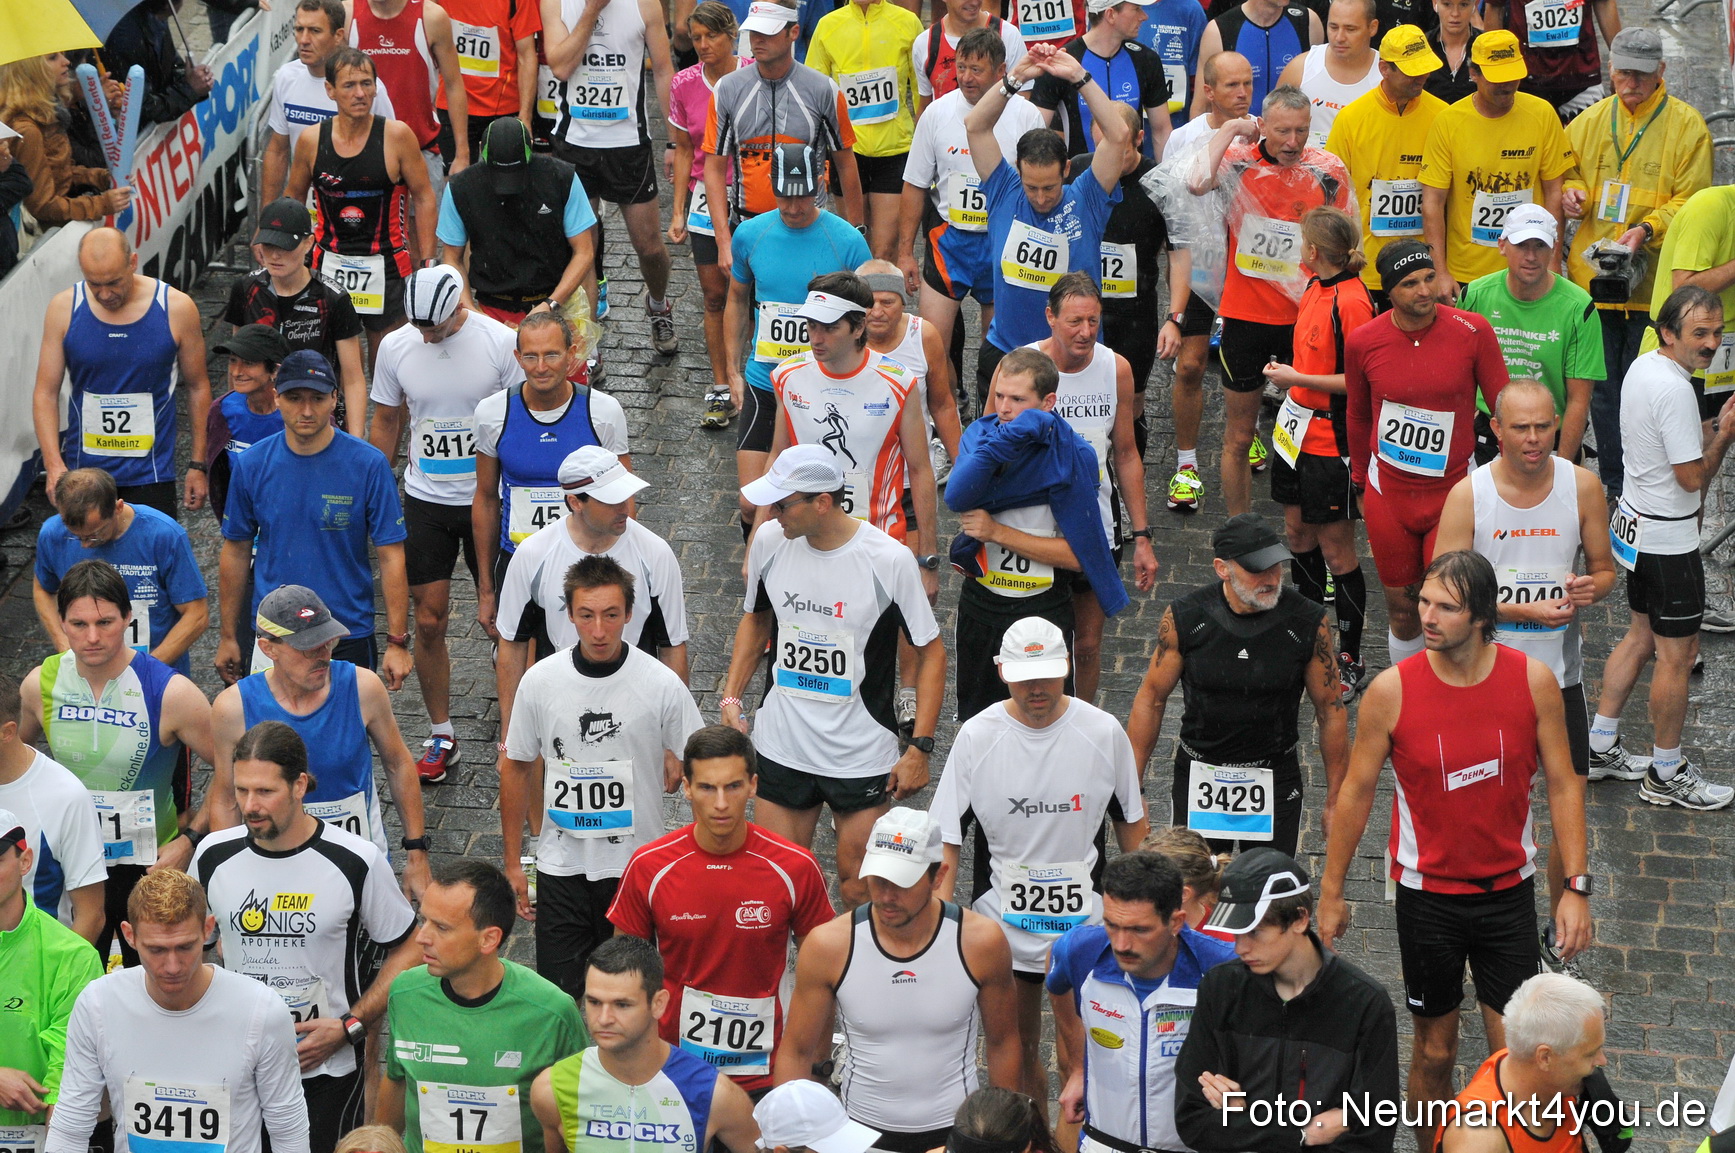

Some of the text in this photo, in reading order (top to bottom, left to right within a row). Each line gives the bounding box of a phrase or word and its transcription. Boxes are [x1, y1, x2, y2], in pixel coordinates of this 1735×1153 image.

[1021, 0, 1067, 22] 2101
[1533, 7, 1580, 30] 3023
[1032, 24, 1060, 33] Thomas
[1546, 31, 1568, 41] Ewald
[457, 37, 490, 59] 810
[576, 86, 624, 106] 3247
[846, 80, 895, 107] 3410
[582, 109, 617, 119] Christian
[959, 188, 987, 211] 15
[1388, 219, 1416, 228] Eduard
[1016, 241, 1059, 271] 640
[335, 269, 373, 293] 607
[1018, 269, 1047, 283] Simon
[770, 318, 810, 344] 606
[1452, 313, 1477, 333] cocoon
[1053, 405, 1111, 418] MECKLER
[102, 410, 132, 434] 52
[96, 437, 141, 449] Karlheinz
[1384, 418, 1446, 453] 2009
[422, 432, 477, 458] 3412
[1398, 450, 1422, 465] Sven
[531, 505, 562, 530] 45
[1510, 528, 1561, 538] KLEBL
[989, 574, 1037, 590] Johannes
[782, 590, 844, 619] Xplus1
[798, 630, 828, 642] BOCK
[783, 641, 847, 676] 3250
[797, 675, 830, 691] Stefen
[58, 704, 138, 728] BOCK
[589, 719, 613, 734] NIKE
[570, 766, 604, 776] BOCK
[1214, 770, 1248, 781] BOCK
[1462, 767, 1486, 782] DEHN
[554, 780, 625, 810] 2109
[1197, 781, 1266, 813] 3429
[1007, 793, 1084, 819] Xplus1
[574, 815, 602, 828] Maxi
[276, 894, 309, 910] TEAM
[1010, 882, 1084, 914] 3255
[1020, 917, 1073, 932] Christian
[240, 937, 306, 948] APOTHEKE
[711, 999, 750, 1013] BOCK
[1089, 1000, 1126, 1019] Bergler
[686, 1011, 766, 1051] 2102
[1156, 1021, 1176, 1033] TOUR
[703, 1050, 742, 1067] Jürgen
[155, 1086, 197, 1099] BOCK
[448, 1089, 487, 1101] BOCK
[590, 1103, 648, 1119] TEAM
[133, 1101, 220, 1141] 3419
[449, 1107, 489, 1142] 17
[586, 1119, 681, 1144] BOCK
